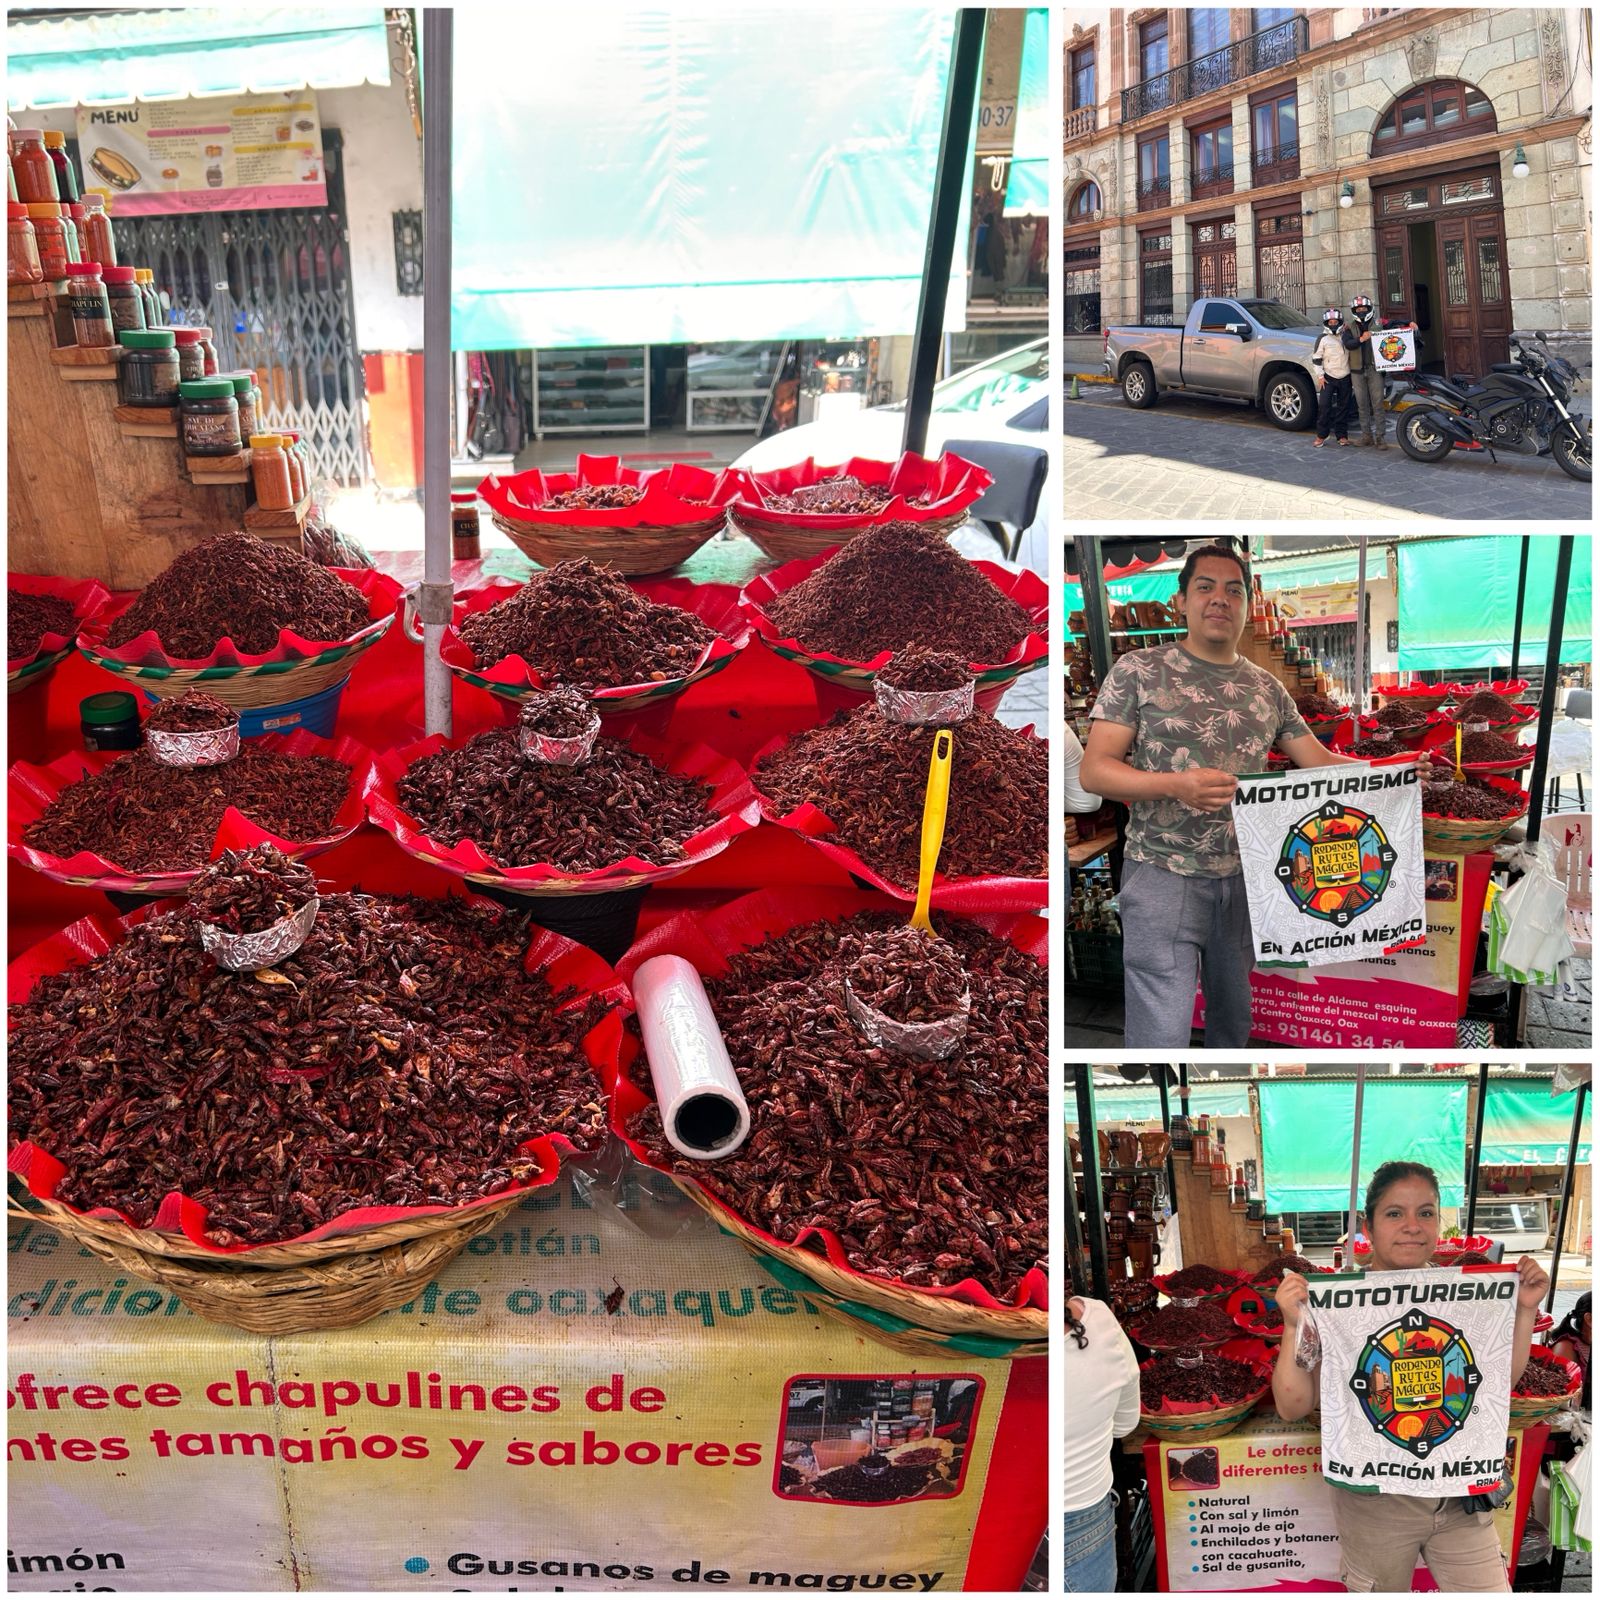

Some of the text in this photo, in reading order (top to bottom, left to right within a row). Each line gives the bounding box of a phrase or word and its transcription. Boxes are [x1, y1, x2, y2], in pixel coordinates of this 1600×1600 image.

[1235, 769, 1418, 806] MOTOTURISMO
[1325, 805, 1338, 815] N
[1383, 852, 1393, 861] E
[1337, 912, 1348, 923] S
[1260, 918, 1423, 956] EN ACCIÓN MÉXICO
[1275, 987, 1285, 997] la
[1287, 990, 1309, 1001] calle
[1313, 992, 1326, 1003] de
[1328, 995, 1369, 1008] Aldama
[1375, 1002, 1417, 1015] esquina
[1260, 1008, 1292, 1019] Centro
[1294, 1012, 1335, 1027] Oaxaca,
[1337, 1017, 1359, 1029] Oax
[1280, 1000, 1321, 1014] enfrente
[1323, 1005, 1340, 1016] del
[1343, 1008, 1379, 1021] mezcal
[1381, 1015, 1399, 1024] oro
[1402, 1016, 1416, 1026] de
[1419, 1020, 1458, 1029] oaxaca
[1277, 1022, 1343, 1045] 951461
[1351, 1034, 1376, 1049] 34
[1309, 1280, 1516, 1309] MOTOTURISMO
[1409, 1316, 1423, 1326] N
[1468, 1373, 1478, 1384] E
[205, 1370, 562, 1417] chapulines
[585, 1374, 668, 1413] de
[150, 1426, 430, 1464] tamaños
[449, 1437, 485, 1470] y
[506, 1430, 763, 1467] sabores
[1247, 1444, 1322, 1458] Le ofrece
[1417, 1441, 1428, 1452] S
[1222, 1463, 1308, 1477] diferentes
[1328, 1460, 1354, 1478] EN
[1361, 1461, 1436, 1481] ACCIÓN
[1442, 1456, 1506, 1477] MÉXIC
[1199, 1496, 1250, 1508] Natural
[1200, 1507, 1299, 1521] Con sal y limón
[1200, 1521, 1296, 1535] Al mojo de ajo
[1201, 1537, 1271, 1548] Enchilados
[1274, 1536, 1282, 1546] y
[1202, 1549, 1298, 1562] con cacahuate.
[447, 1552, 945, 1592] Gusanos de maguey
[1202, 1558, 1306, 1573] Sal de gusanito,
